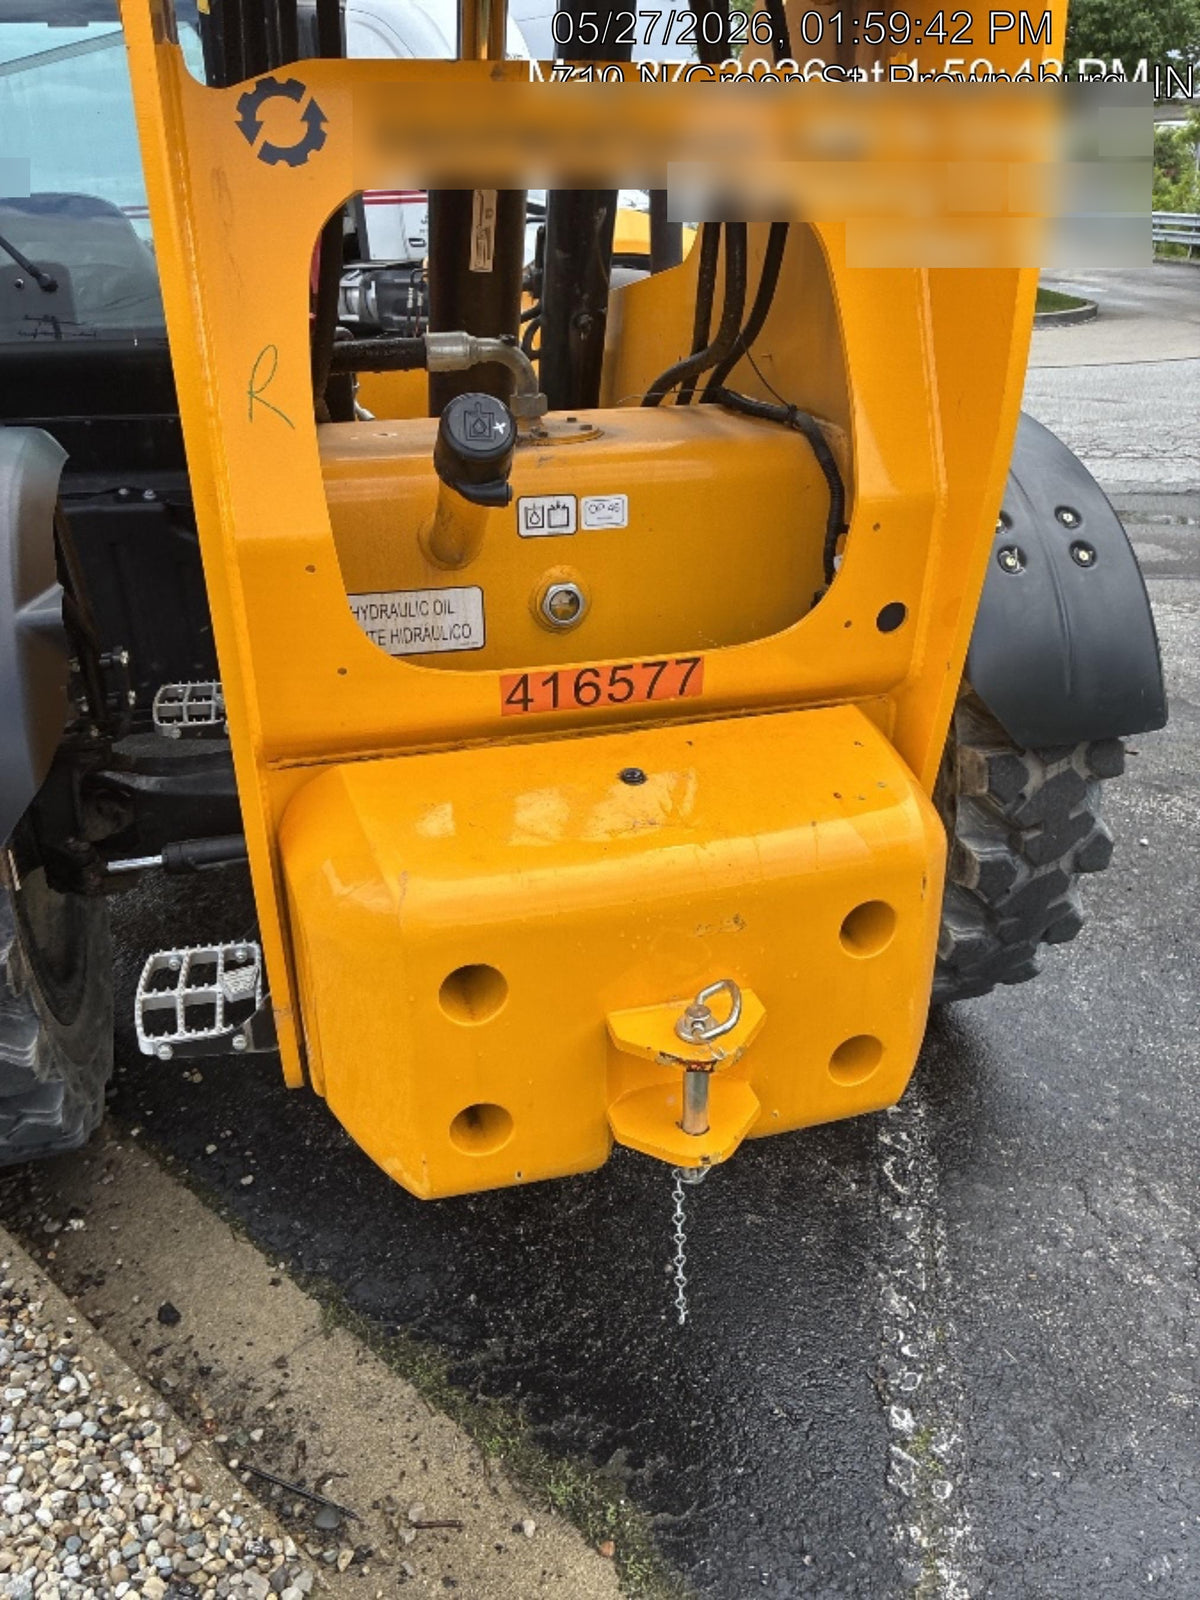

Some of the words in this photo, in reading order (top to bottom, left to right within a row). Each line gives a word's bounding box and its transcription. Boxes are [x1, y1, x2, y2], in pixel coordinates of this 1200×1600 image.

[247, 343, 295, 430] R
[350, 600, 429, 621] HYDRAULIC
[432, 599, 455, 616] OIL
[505, 657, 701, 712] 416577
